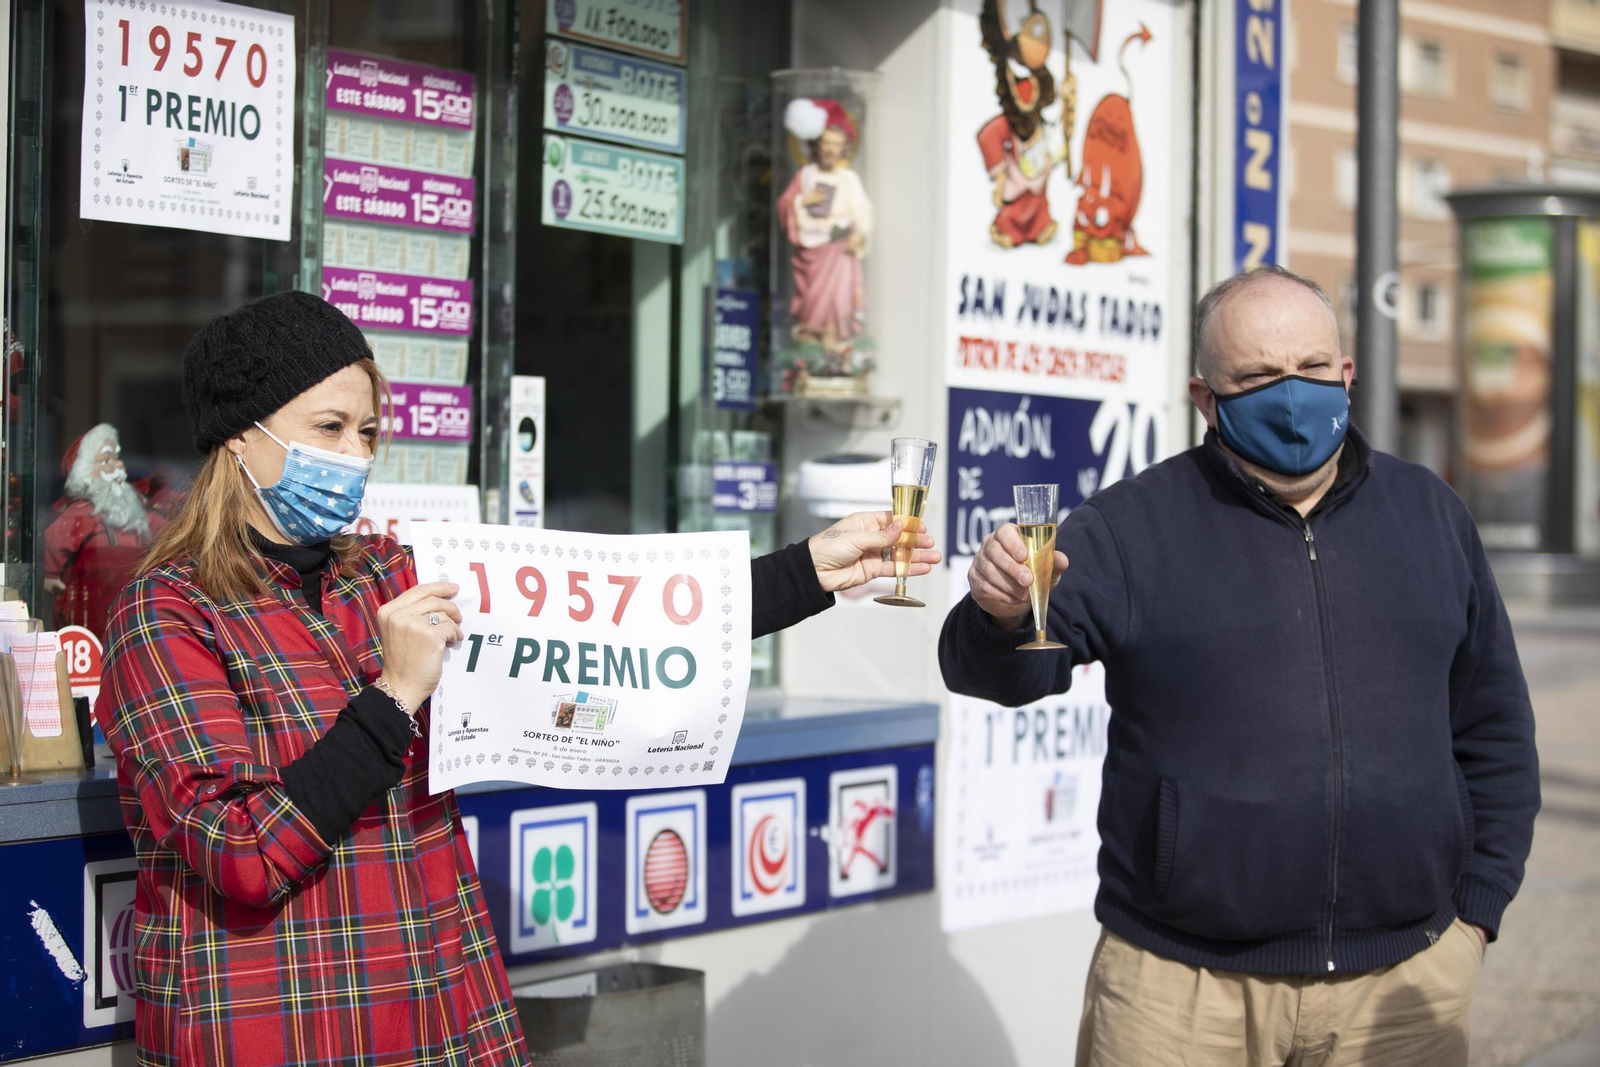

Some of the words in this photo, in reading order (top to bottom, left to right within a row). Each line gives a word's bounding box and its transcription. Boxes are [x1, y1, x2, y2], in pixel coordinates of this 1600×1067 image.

[118, 19, 267, 88] 19570
[336, 88, 362, 105] ESTE
[363, 90, 406, 113] SÁBADO
[620, 65, 679, 104] BOTE
[146, 88, 261, 141] PREMIO
[618, 157, 678, 195] BOTE
[336, 195, 362, 211] ESTE
[363, 195, 406, 218] SÁBADO
[361, 302, 404, 324] SÁBADO
[958, 273, 1006, 319] SAN
[1017, 281, 1088, 331] JUDAS
[958, 466, 984, 500] DE
[469, 561, 703, 627] 19570
[63, 639, 92, 674] 18
[508, 637, 697, 689] PREMIO
[523, 730, 559, 742] SORTEO
[561, 735, 573, 744] DE
[674, 742, 705, 751] Nacional
[1012, 705, 1108, 764] PREMI
